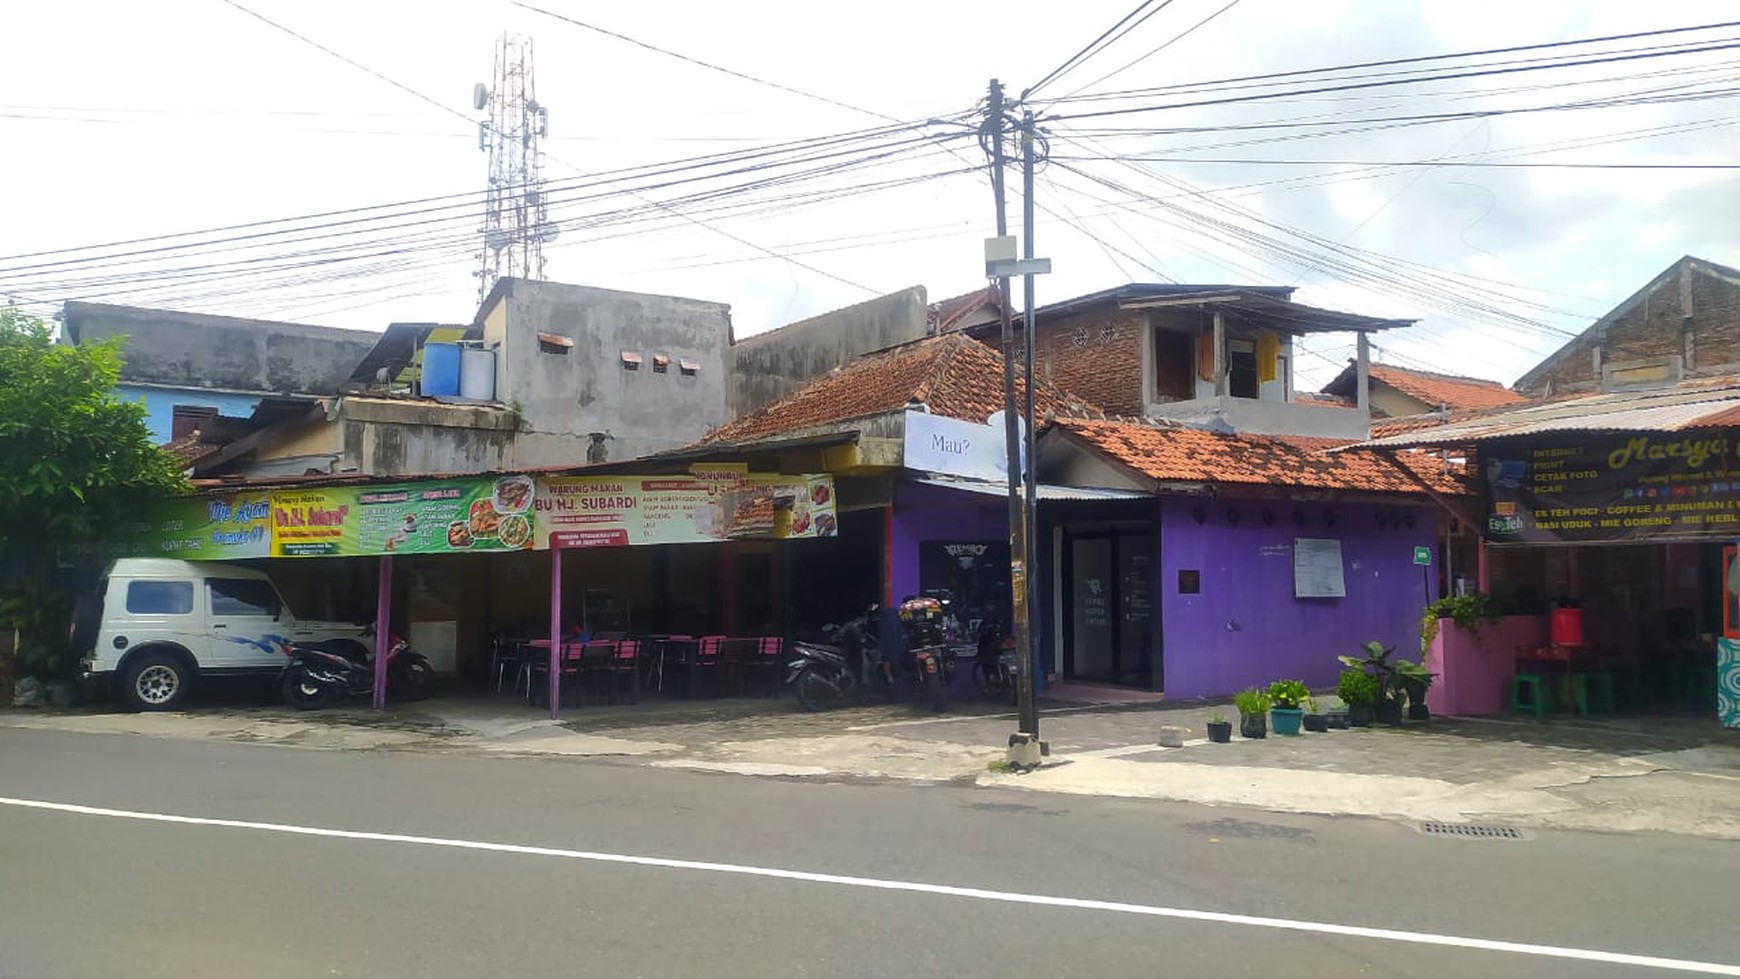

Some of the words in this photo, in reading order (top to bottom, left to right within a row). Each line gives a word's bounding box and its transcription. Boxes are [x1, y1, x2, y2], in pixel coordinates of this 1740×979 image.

[931, 434, 970, 455] Mau?
[1608, 437, 1728, 469] Marsya
[1534, 472, 1567, 482] CETAK
[1570, 470, 1598, 480] FOTO
[549, 484, 589, 495] WARUNG
[590, 483, 623, 493] MAKAN
[535, 498, 551, 511] BU
[556, 498, 578, 510] HJ.
[581, 496, 637, 509] SUBARDI
[1550, 508, 1570, 517] TEH
[1573, 507, 1599, 516] POCI
[1607, 504, 1652, 515] COFFEE
[1665, 501, 1724, 512] MINUMAN
[1506, 515, 1524, 530] Teh
[1535, 520, 1561, 530] NASI
[1564, 519, 1592, 529] UDUK
[1600, 519, 1621, 528] MIE
[1623, 516, 1672, 527] GORENG
